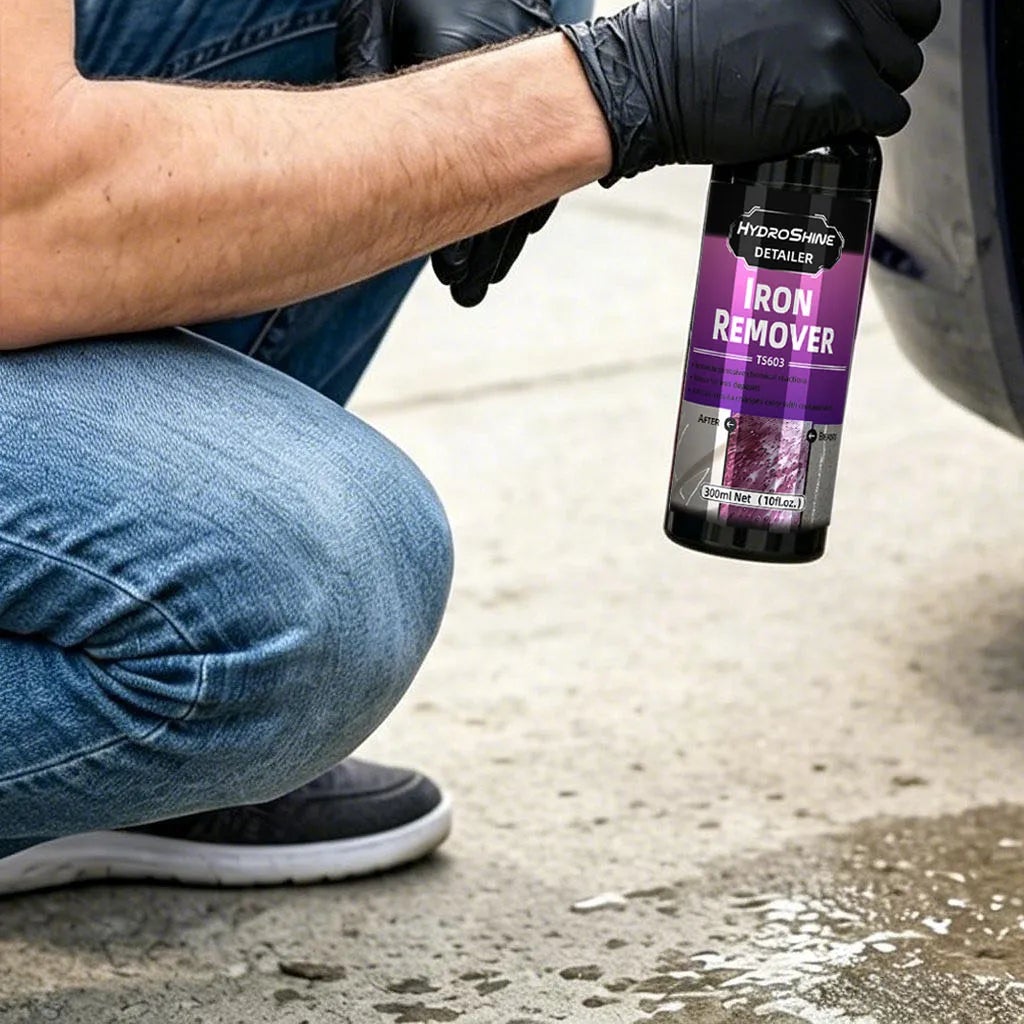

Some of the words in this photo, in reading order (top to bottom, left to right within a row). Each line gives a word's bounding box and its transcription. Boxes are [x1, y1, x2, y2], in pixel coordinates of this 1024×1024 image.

[736, 221, 836, 247] HYDROSHINE
[754, 246, 814, 265] DETAILER
[743, 276, 813, 317] IRON
[712, 308, 835, 355] REMOVER
[756, 354, 785, 369] TS603
[698, 414, 720, 427] AFTER
[703, 486, 732, 501] 300ml
[733, 491, 752, 504] Net
